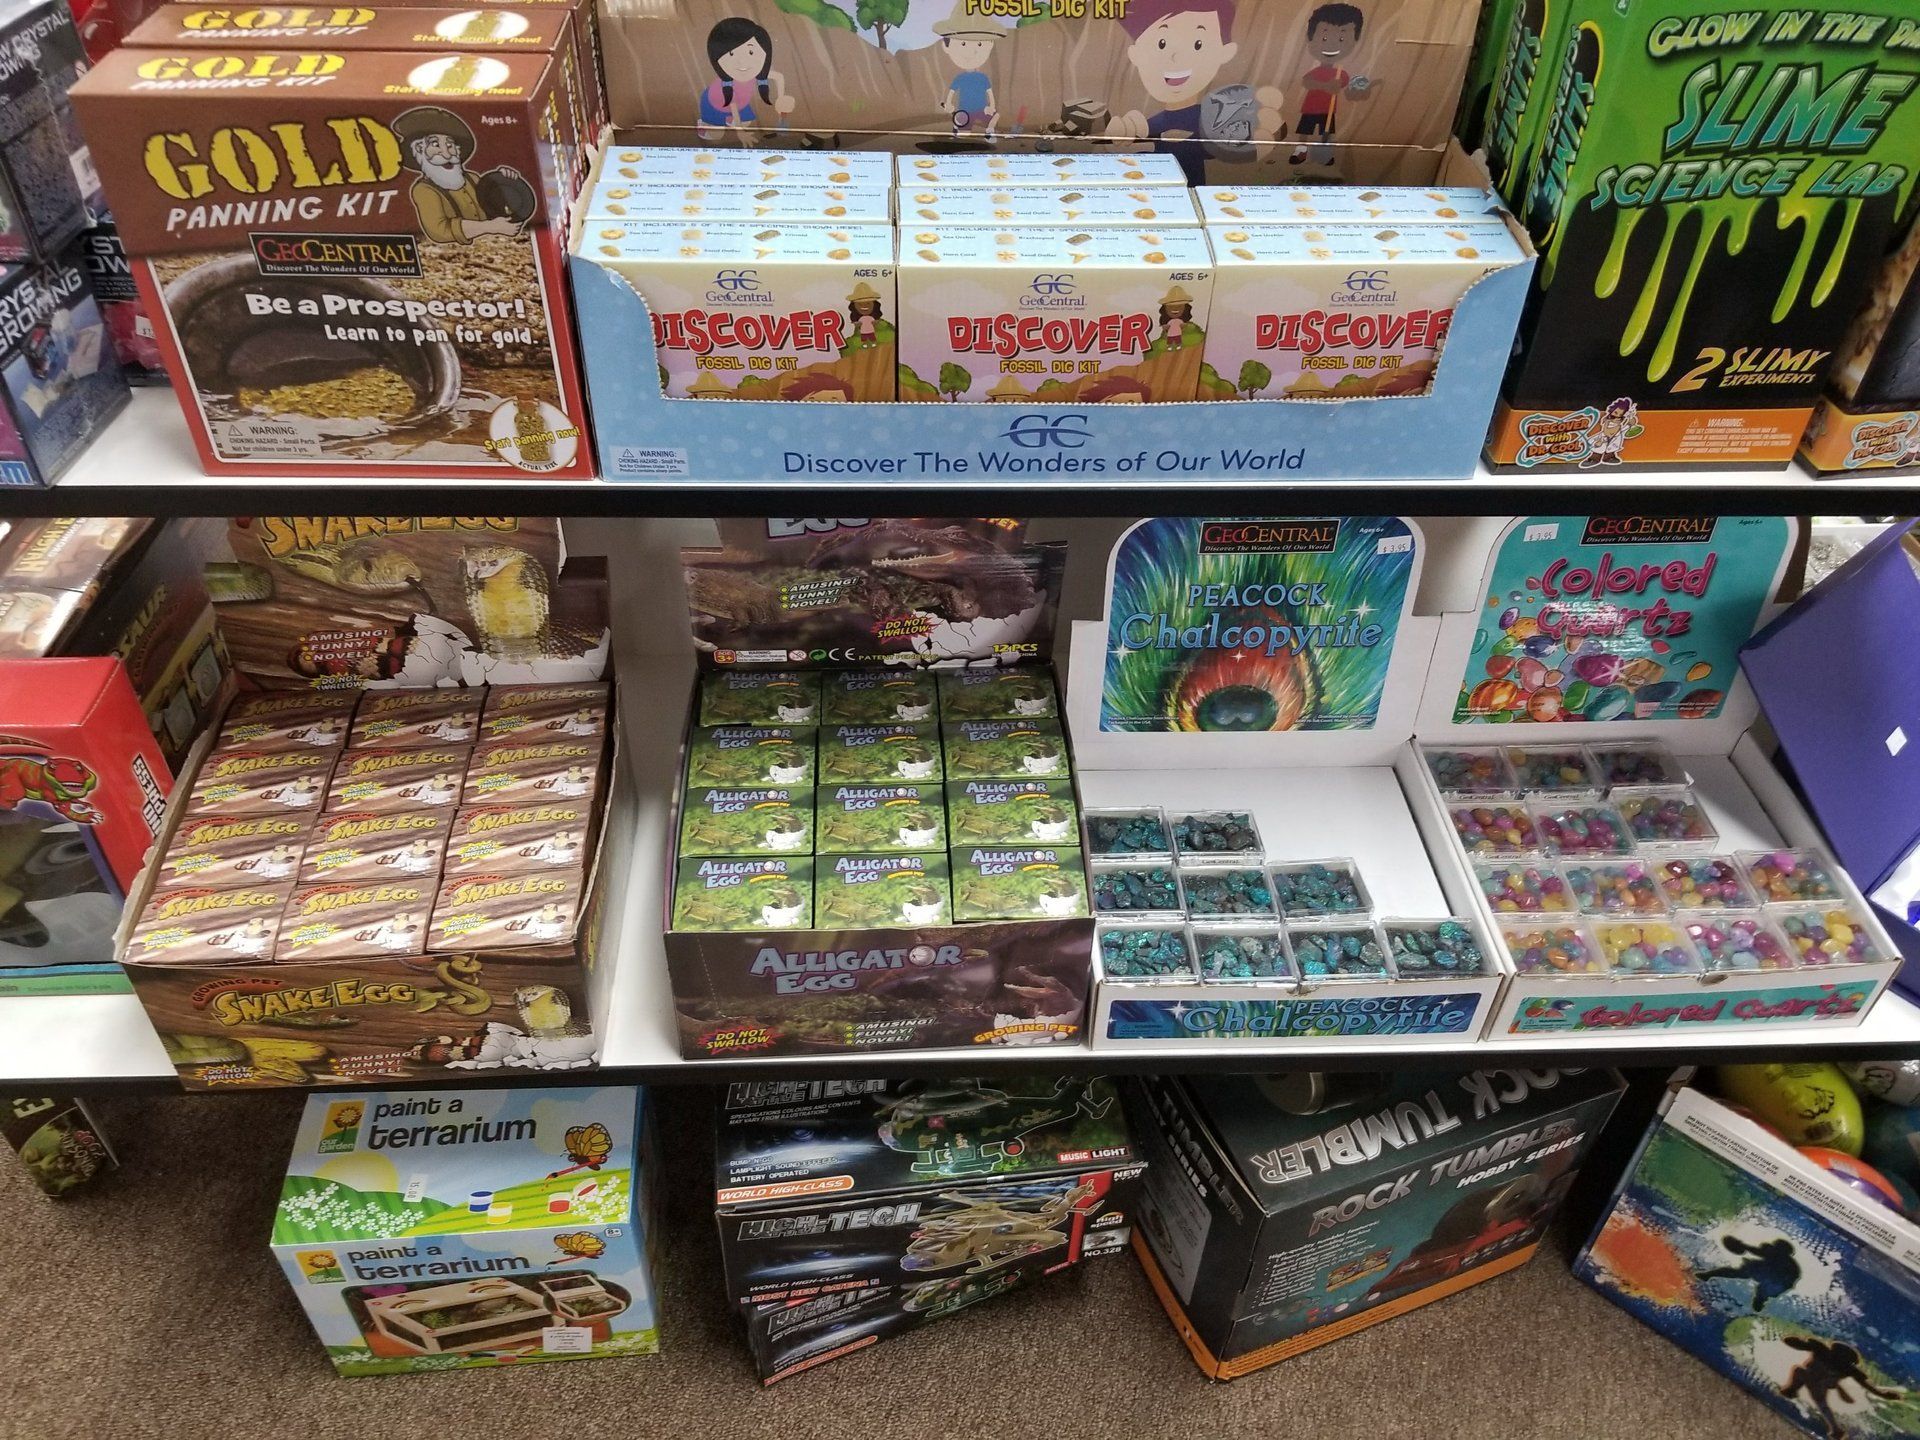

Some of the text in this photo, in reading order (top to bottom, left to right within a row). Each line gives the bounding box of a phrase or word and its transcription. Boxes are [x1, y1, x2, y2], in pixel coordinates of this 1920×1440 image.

[1648, 12, 1762, 58] GLOW
[1763, 10, 1812, 42] IN
[1812, 12, 1888, 42] THE
[137, 54, 345, 79] GOLD
[383, 85, 424, 95] Start
[488, 86, 522, 95] now!
[1665, 60, 1918, 155] SLIME
[481, 116, 518, 126] Ages 8+
[144, 117, 402, 199] GOLD
[1591, 158, 1908, 211] SCIENCE LAB
[166, 190, 398, 231] PANNING KIT
[266, 264, 415, 274] Discover The Wonders Of Our World
[854, 269, 892, 277] AGES 6+
[245, 293, 525, 322] Be a Prospector!
[324, 324, 539, 348] Learn to pan for gold.
[947, 313, 1152, 358] DISCOVER
[697, 356, 798, 370] FOSSIL DIG KIT
[1000, 360, 1101, 373] FOSSIL DIG KIT
[1301, 355, 1403, 370] FOSSIL DIG KIT
[1670, 347, 1831, 393] 2 SLIMY
[1719, 372, 1816, 387] EXPERIMENTS
[249, 426, 298, 435] WARNING:
[1527, 416, 1589, 436] DISCOVER
[484, 426, 580, 451] Start panning now!
[1545, 432, 1569, 443] with
[1528, 441, 1583, 455] DR. COOL
[784, 448, 1305, 473] Discover The Wonders of Our World
[1309, 543, 1331, 551] World
[1541, 552, 1717, 599] Colored
[790, 577, 857, 593] AMUSING!
[790, 589, 839, 600] FUNNY!
[1188, 582, 1328, 607] PEACOCK
[790, 598, 837, 609] NOVEL!
[885, 618, 925, 629] DO NOT
[1537, 598, 1692, 639] Quartz
[308, 629, 388, 642] AMUSING!
[877, 624, 928, 638] SWALLOW
[1121, 611, 1381, 657] Chalcopyrite
[311, 640, 370, 651] FUNNY!
[993, 643, 1037, 653] 12 PCS
[313, 651, 370, 661] NOVEL!
[834, 856, 923, 871] ALLIGATOR
[969, 849, 1058, 864] ALLIGATOR
[697, 860, 787, 876] ALLIGATOR
[979, 862, 1015, 876] EGG
[705, 873, 741, 888] EGG
[844, 869, 880, 884] EGG
[452, 877, 566, 907] SNAKE EGG
[157, 890, 278, 920] SNAKE EGG
[301, 887, 420, 914] SNAKE EGG
[750, 944, 963, 975] ALLIGATOR
[775, 972, 857, 994] EGG
[191, 978, 282, 1004] GROWING PET
[211, 978, 416, 1026] SNAKE EGG
[1295, 999, 1413, 1014] PEACOCK
[1580, 993, 1859, 1027] Colored Quartz
[856, 1018, 934, 1030] AMUSING!
[1183, 1006, 1465, 1034] Chalcopyrite
[715, 1029, 765, 1041] DO NOT
[854, 1036, 912, 1045] NOVEL!
[855, 1028, 914, 1038] FUNNY!
[974, 1023, 1077, 1043] GROWING PET
[706, 1036, 769, 1049] SWALLOW
[339, 1050, 418, 1064] AMUSING!
[340, 1059, 401, 1070] FUNNY!
[202, 1072, 252, 1082] SWALLOW
[207, 1066, 246, 1076] DO NOT
[345, 1067, 401, 1077] NOVEL!
[373, 1097, 463, 1121] paint a
[368, 1115, 537, 1150] terrarium
[1249, 1090, 1461, 1184] TUMBLER
[320, 1142, 354, 1152] garden
[1060, 1148, 1126, 1162] MUSIC LIGHT
[1456, 1132, 1585, 1188] HOBBY SERIES
[730, 1169, 809, 1183] BATTERY OPERATED
[1114, 1168, 1143, 1178] NEW
[1308, 1118, 1576, 1237] ROCK TUMBLER
[720, 1180, 844, 1200] WORLD HIGH-CLASS
[348, 1246, 442, 1264] paint a
[354, 1254, 530, 1280] terrarium
